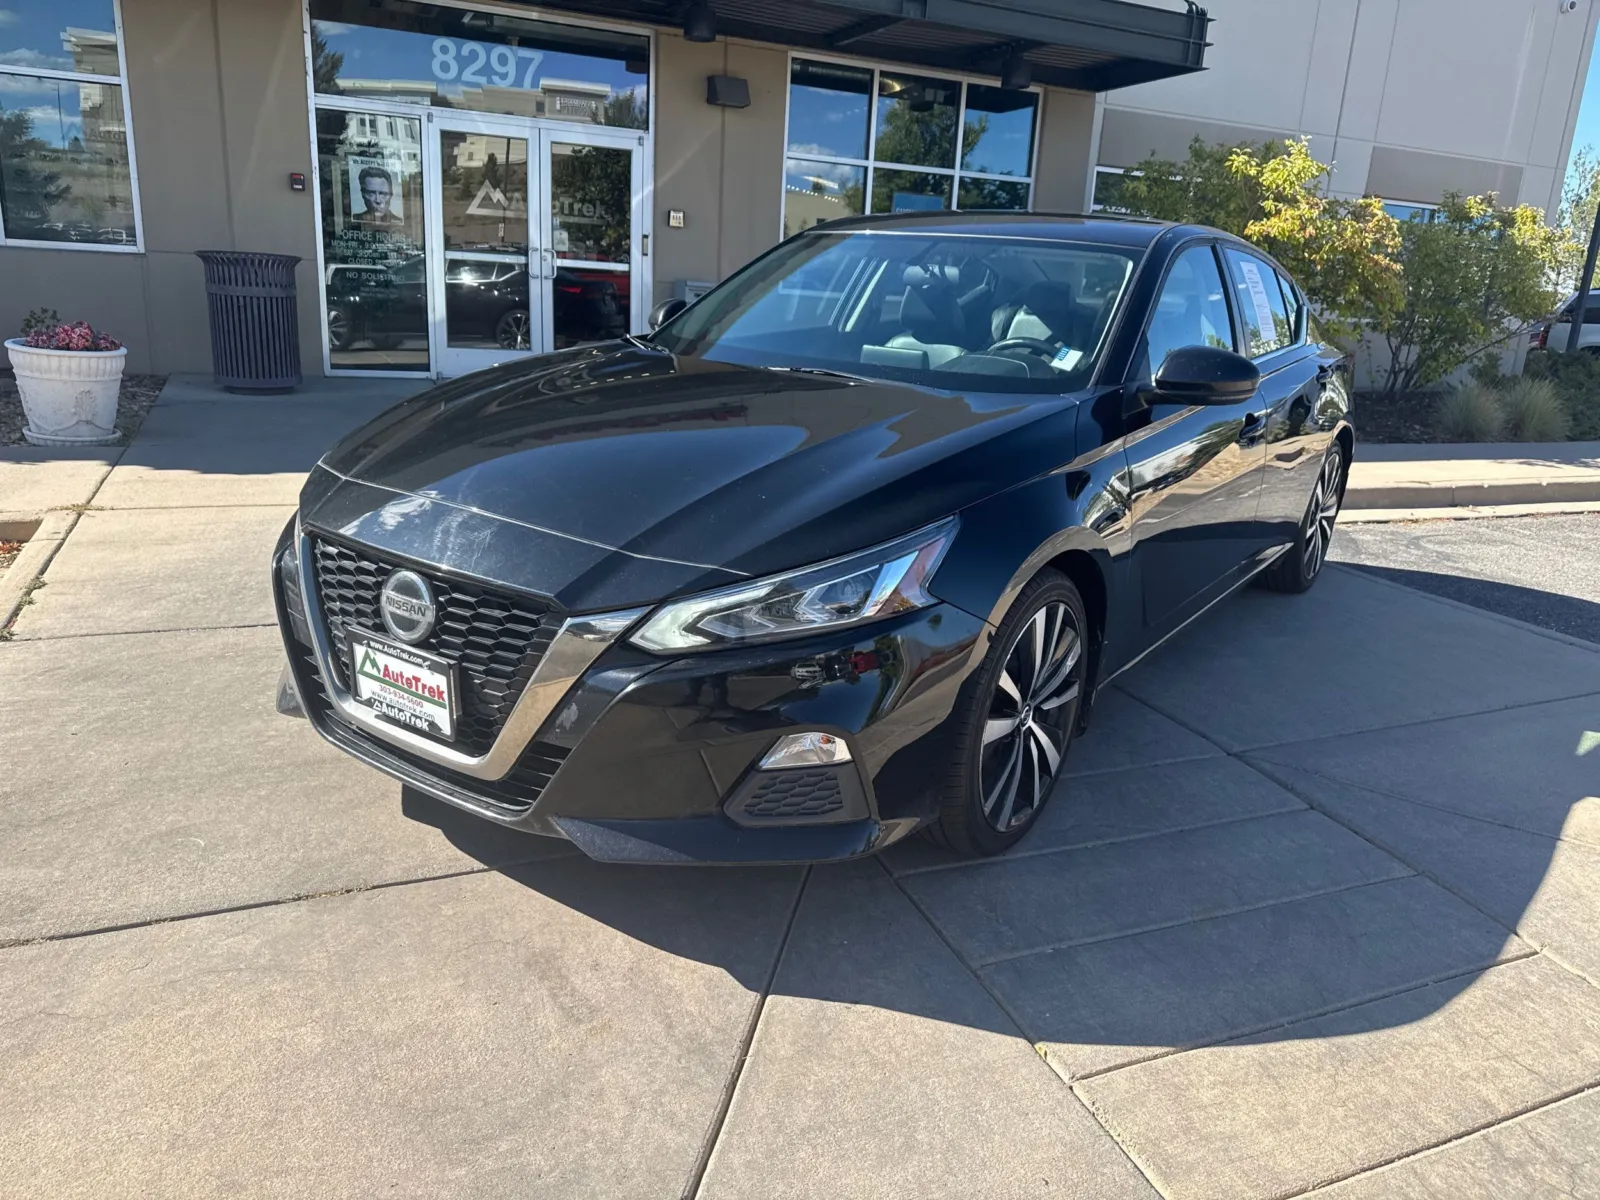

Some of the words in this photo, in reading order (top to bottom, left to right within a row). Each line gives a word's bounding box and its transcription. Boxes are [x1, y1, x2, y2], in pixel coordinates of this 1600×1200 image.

[432, 37, 544, 89] 8297
[342, 230, 373, 241] OFFICE
[376, 232, 406, 242] HOURS
[346, 271, 359, 279] NO
[386, 595, 426, 617] NISSAN
[369, 640, 424, 666] www.AutoTrek.com
[382, 663, 446, 702] AutoTrek
[381, 702, 430, 731] AutoTrek
